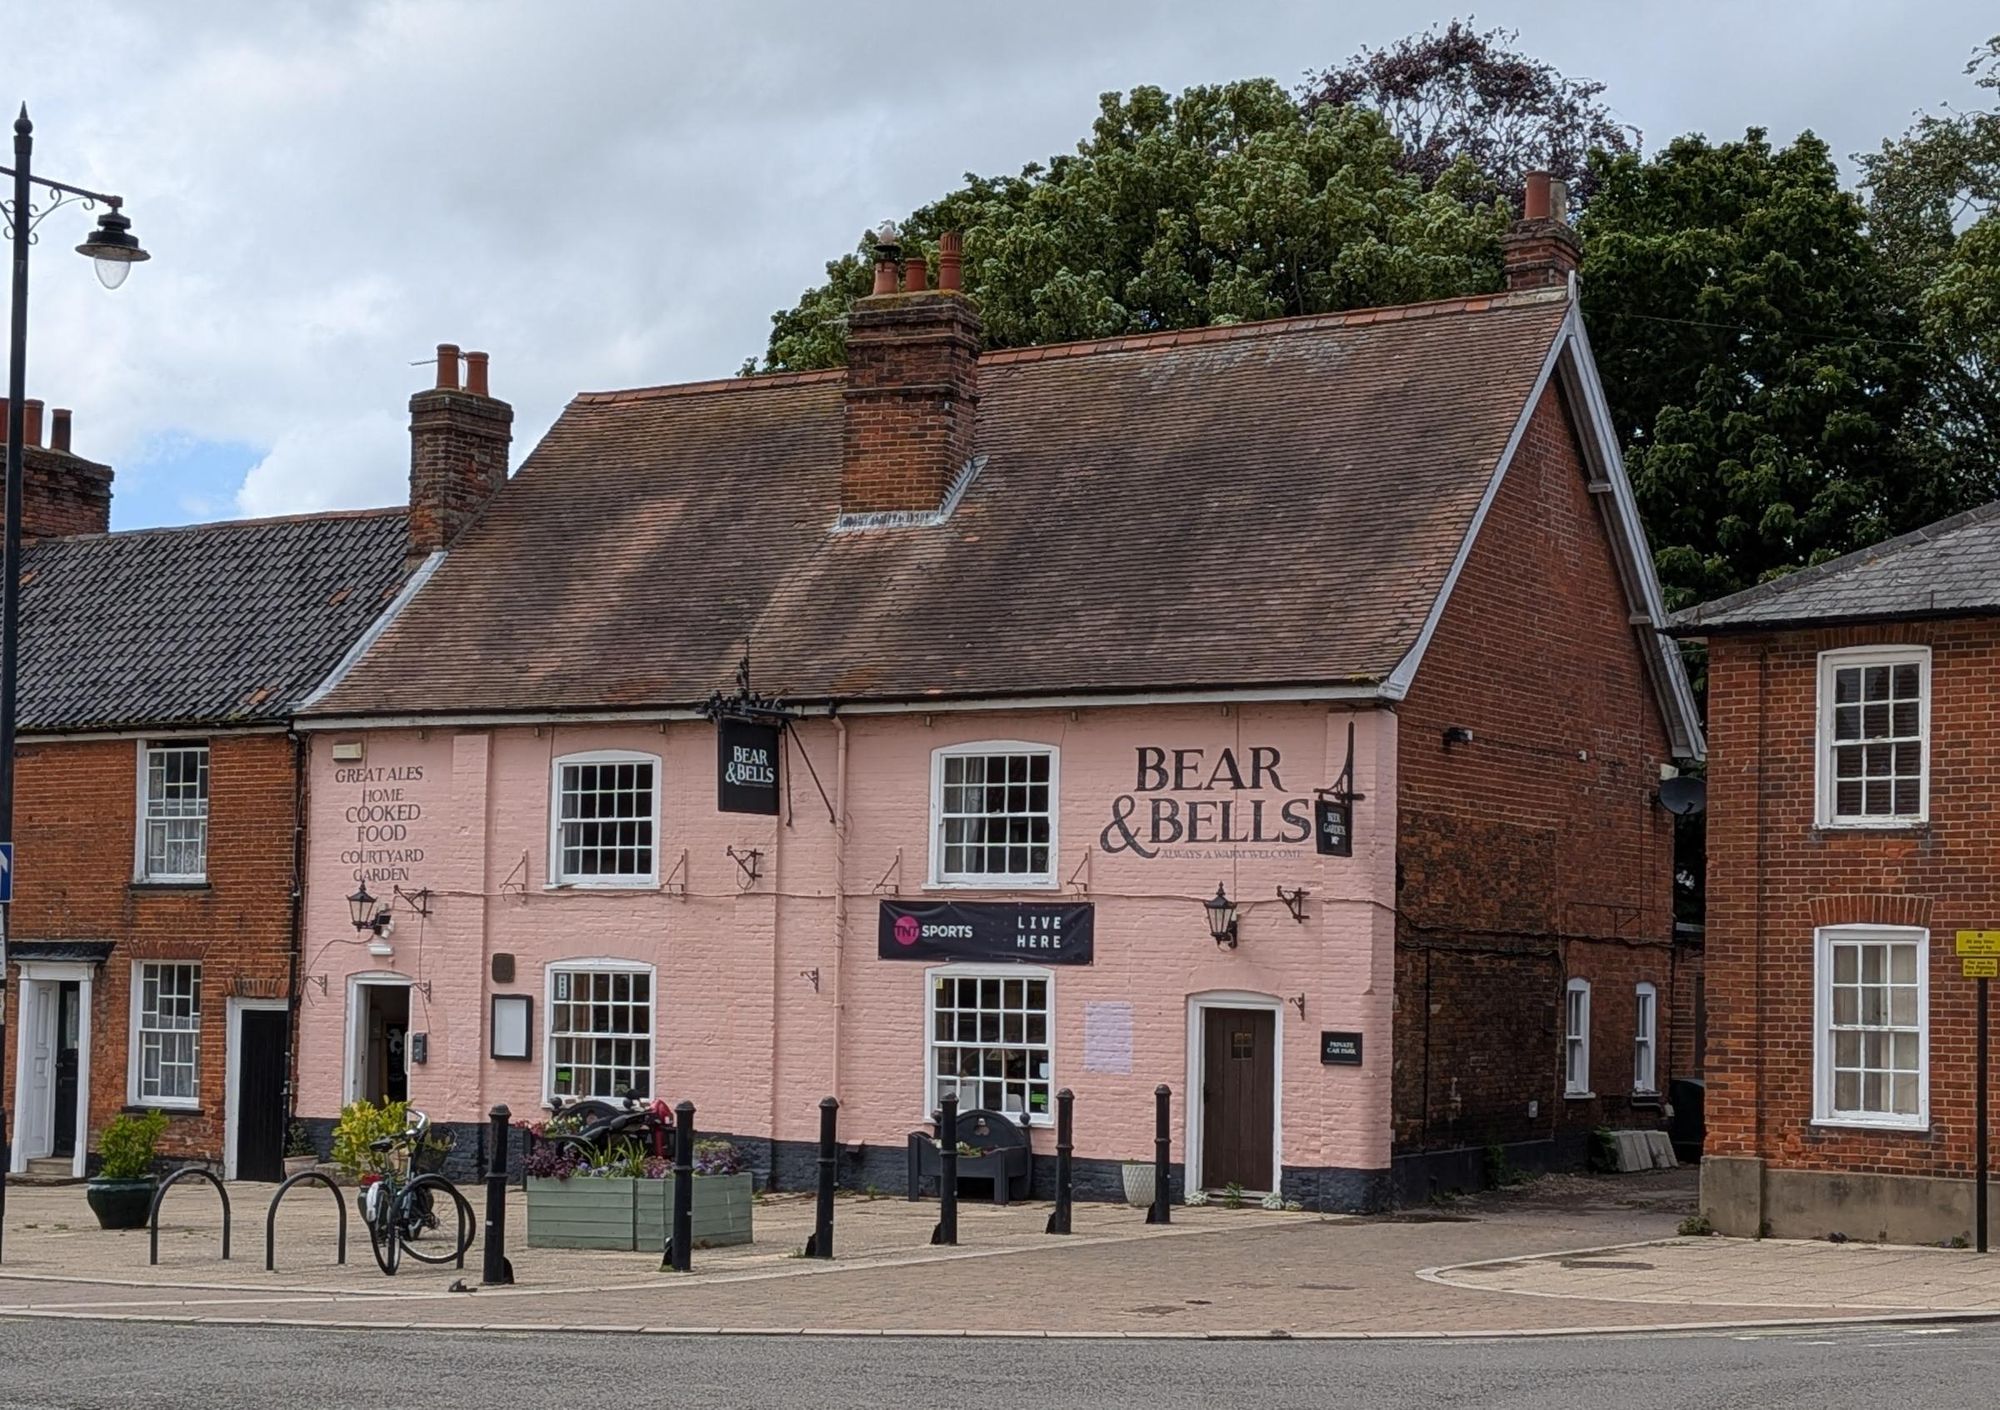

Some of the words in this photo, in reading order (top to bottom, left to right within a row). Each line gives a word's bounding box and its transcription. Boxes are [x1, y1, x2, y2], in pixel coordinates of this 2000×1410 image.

[733, 745, 768, 766] BEAR
[335, 767, 385, 783] GREAT
[387, 766, 424, 781] ALES
[1134, 746, 1288, 792] BEAR
[363, 788, 404, 803] HOME
[346, 804, 421, 823] COOKED
[357, 825, 407, 842] FOOD
[340, 849, 424, 864] COURTYARD
[1161, 849, 1202, 859] ALWAYS
[1203, 849, 1212, 859] A
[353, 867, 409, 882] GARDEN
[1018, 915, 1062, 929] LIVE
[921, 925, 973, 938] SPORTS
[1017, 935, 1062, 948] HERE
